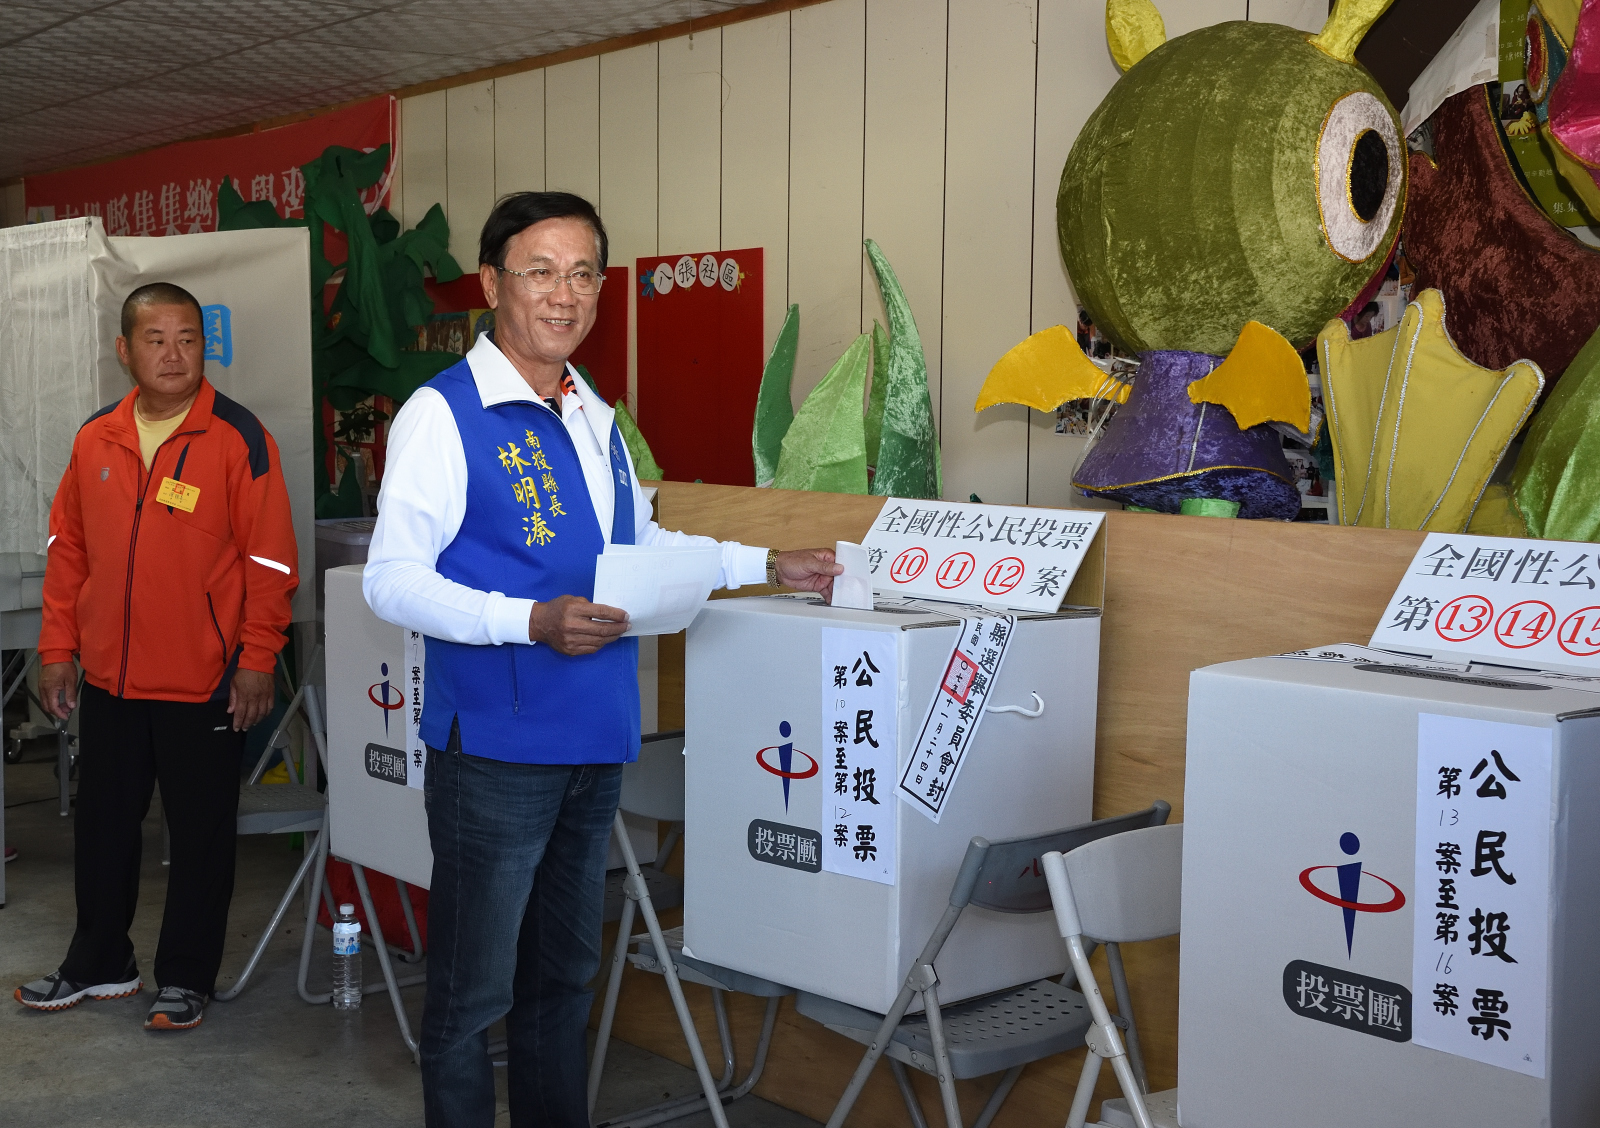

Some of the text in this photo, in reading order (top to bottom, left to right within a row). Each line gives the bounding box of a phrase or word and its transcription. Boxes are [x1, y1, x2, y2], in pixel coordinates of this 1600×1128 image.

[658, 258, 736, 288] 八張社區
[496, 442, 556, 547] 林明溱
[524, 428, 567, 518] 南投縣長
[876, 505, 1093, 550] 全國性公民投票
[1416, 543, 1600, 589] 全國性公
[915, 617, 983, 785] 民國一〇七年十一月二十四日
[927, 615, 1012, 802] 縣選舉委員會封
[851, 650, 880, 862] 公民投票
[1467, 749, 1521, 1042] 公民投票
